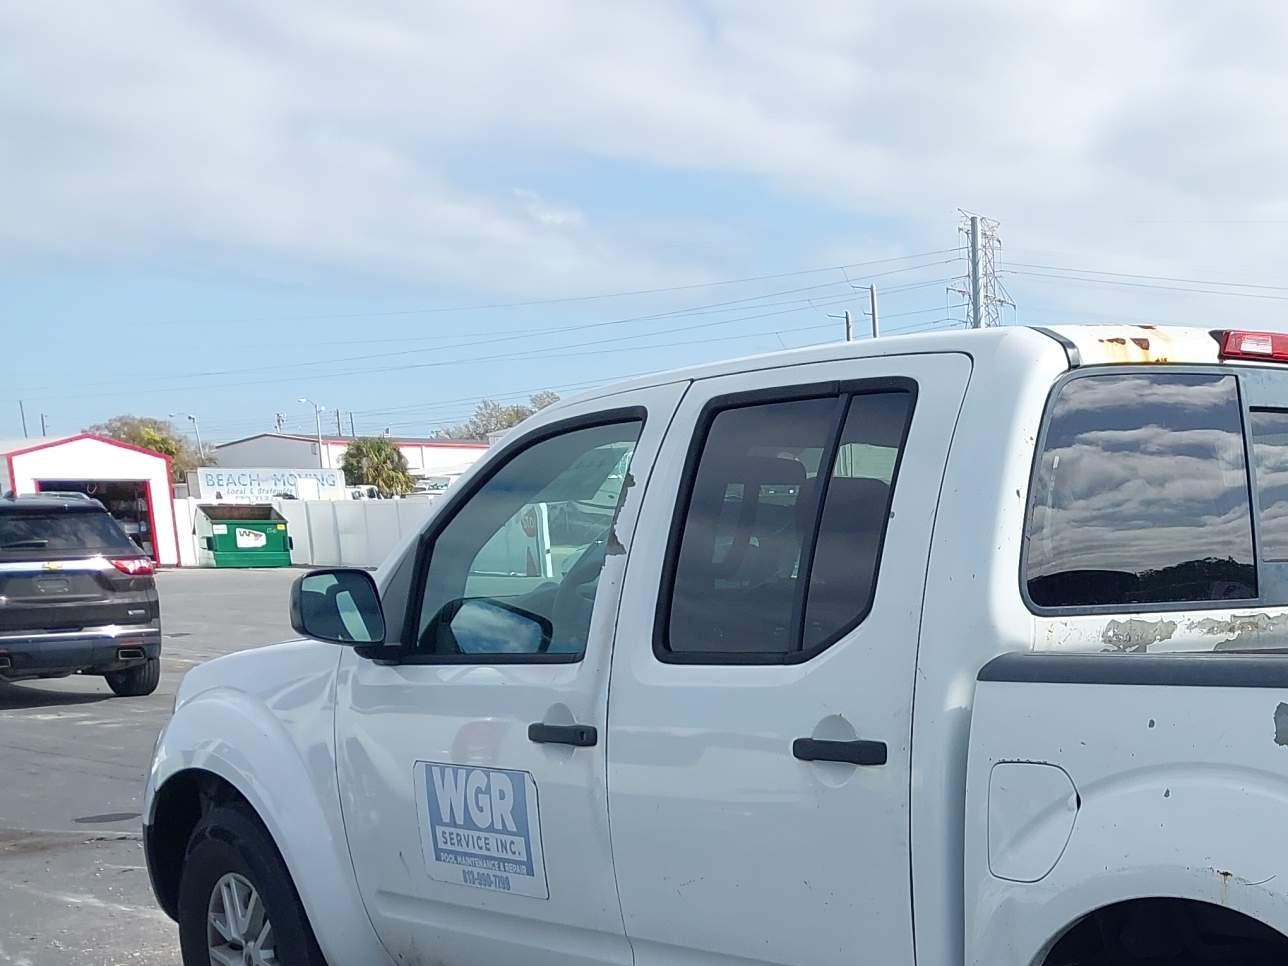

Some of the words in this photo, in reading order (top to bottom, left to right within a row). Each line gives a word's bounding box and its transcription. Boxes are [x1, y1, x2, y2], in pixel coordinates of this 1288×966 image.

[206, 473, 261, 487] BEACH
[431, 767, 517, 831] WGR
[442, 831, 491, 851] SERVICE
[495, 838, 521, 857] INC.
[440, 852, 457, 864] POOL
[504, 862, 528, 874] REPAIR
